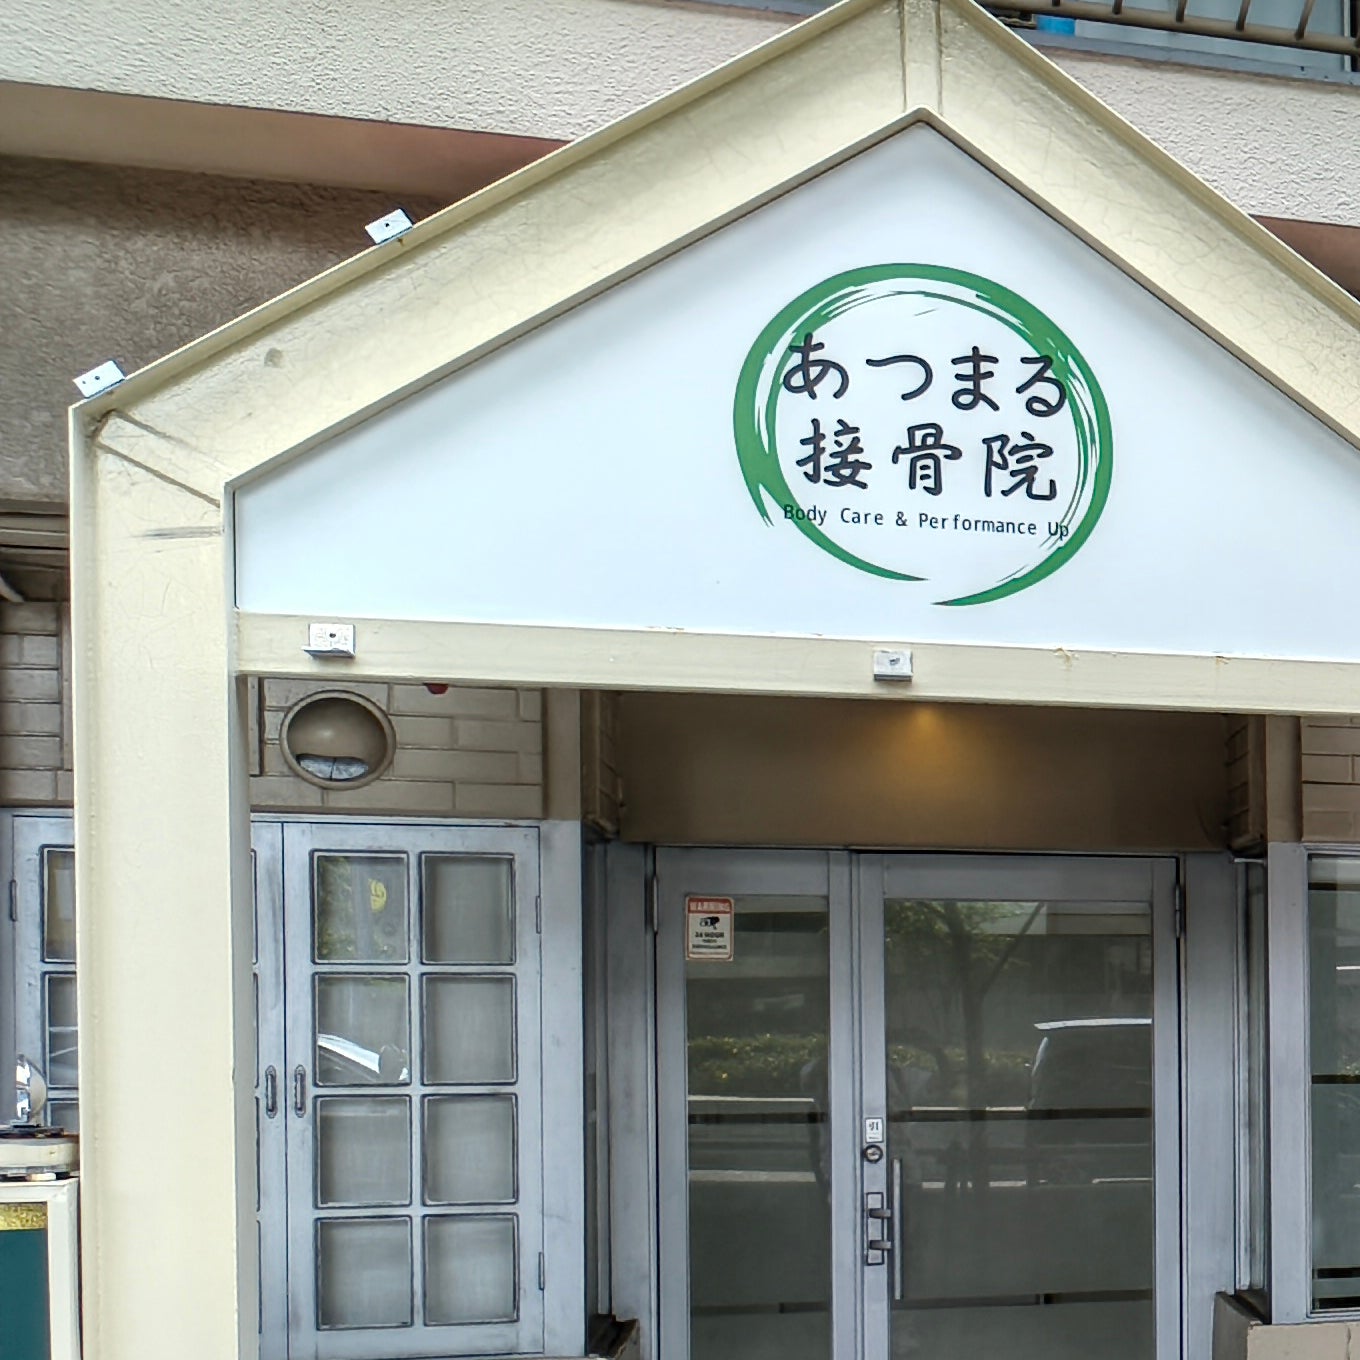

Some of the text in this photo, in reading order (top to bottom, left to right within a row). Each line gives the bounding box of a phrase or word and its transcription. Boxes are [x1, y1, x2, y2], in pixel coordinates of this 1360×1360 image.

[782, 331, 1067, 417] あつまる
[795, 417, 1058, 502] 接骨院
[783, 503, 1069, 538] Body Care & Performance Up
